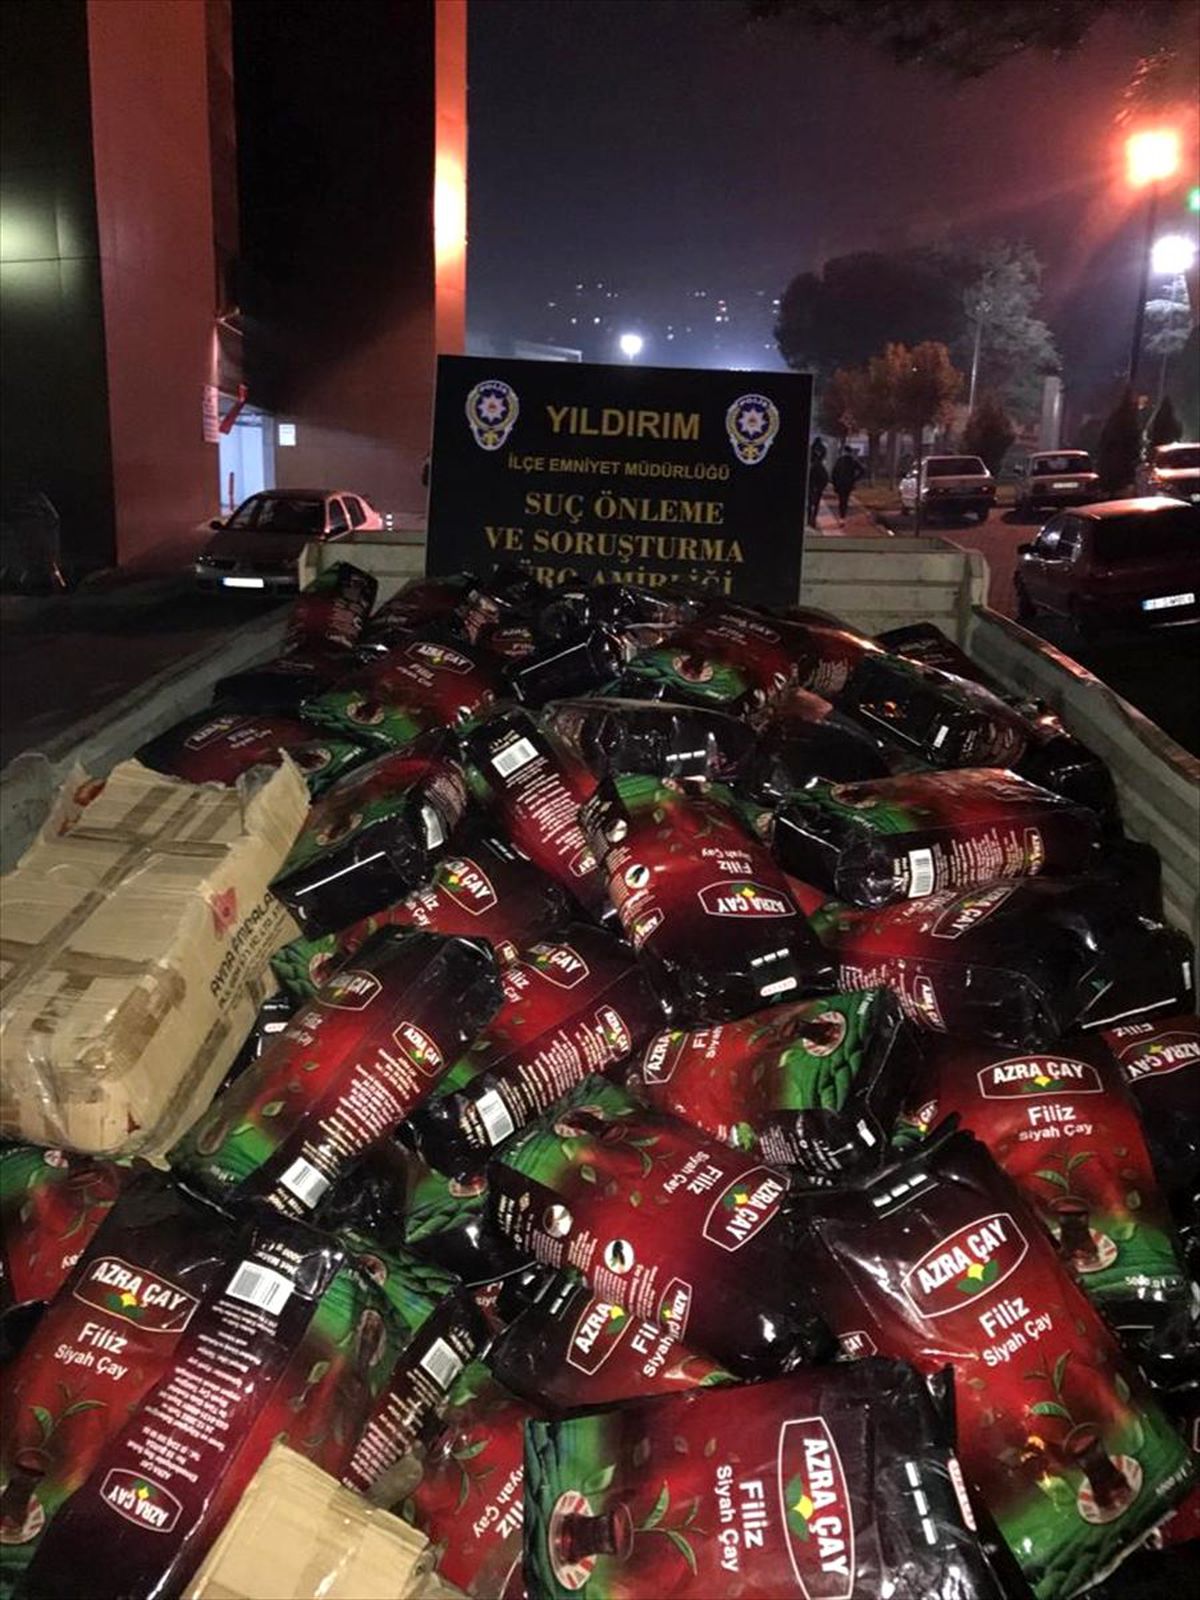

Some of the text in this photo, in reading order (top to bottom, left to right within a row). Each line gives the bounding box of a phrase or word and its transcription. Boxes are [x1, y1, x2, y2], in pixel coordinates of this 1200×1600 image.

[546, 405, 700, 441] YILDIRIM
[508, 452, 731, 481] İLÇE EMNİYET MÜDÜRLÜĞÜ
[524, 490, 724, 526] SUÇ ÖNLEME
[484, 526, 744, 564] VE SORUŞTURMA
[719, 859, 753, 875] Filiz
[460, 873, 491, 899] ÇAY
[717, 893, 786, 914] AZRA ÇAY
[952, 908, 983, 931] ÇAY
[548, 950, 582, 974] ÇAY
[1111, 1022, 1154, 1038] Filiz
[647, 1034, 673, 1071] AZRA
[1127, 1042, 1200, 1078] AZRA ÇAY
[993, 1061, 1085, 1084] AZRA ÇAY
[1018, 1121, 1094, 1142] Siyah Çay
[1027, 1104, 1077, 1126] Filiz
[663, 1168, 688, 1195] Çay
[687, 1165, 724, 1195] Filiz
[725, 1178, 784, 1241] AZRA ÇAY
[916, 1219, 1009, 1295] AZRA ÇAY
[92, 1261, 188, 1313] AZRA ÇAY
[575, 1302, 613, 1355] AZRA
[978, 1297, 1031, 1339] Filiz
[77, 1322, 130, 1355] Filiz
[631, 1322, 660, 1355] Fil
[982, 1311, 1052, 1368] Siyah Çay
[54, 1343, 129, 1382] Siyah Çay
[108, 1484, 170, 1527] AZRA ÇAY
[473, 1504, 500, 1539] Çay
[715, 1464, 740, 1574] Siyah Çay
[739, 1480, 765, 1550] Filiz
[803, 1437, 850, 1577] AZRA ÇAY
